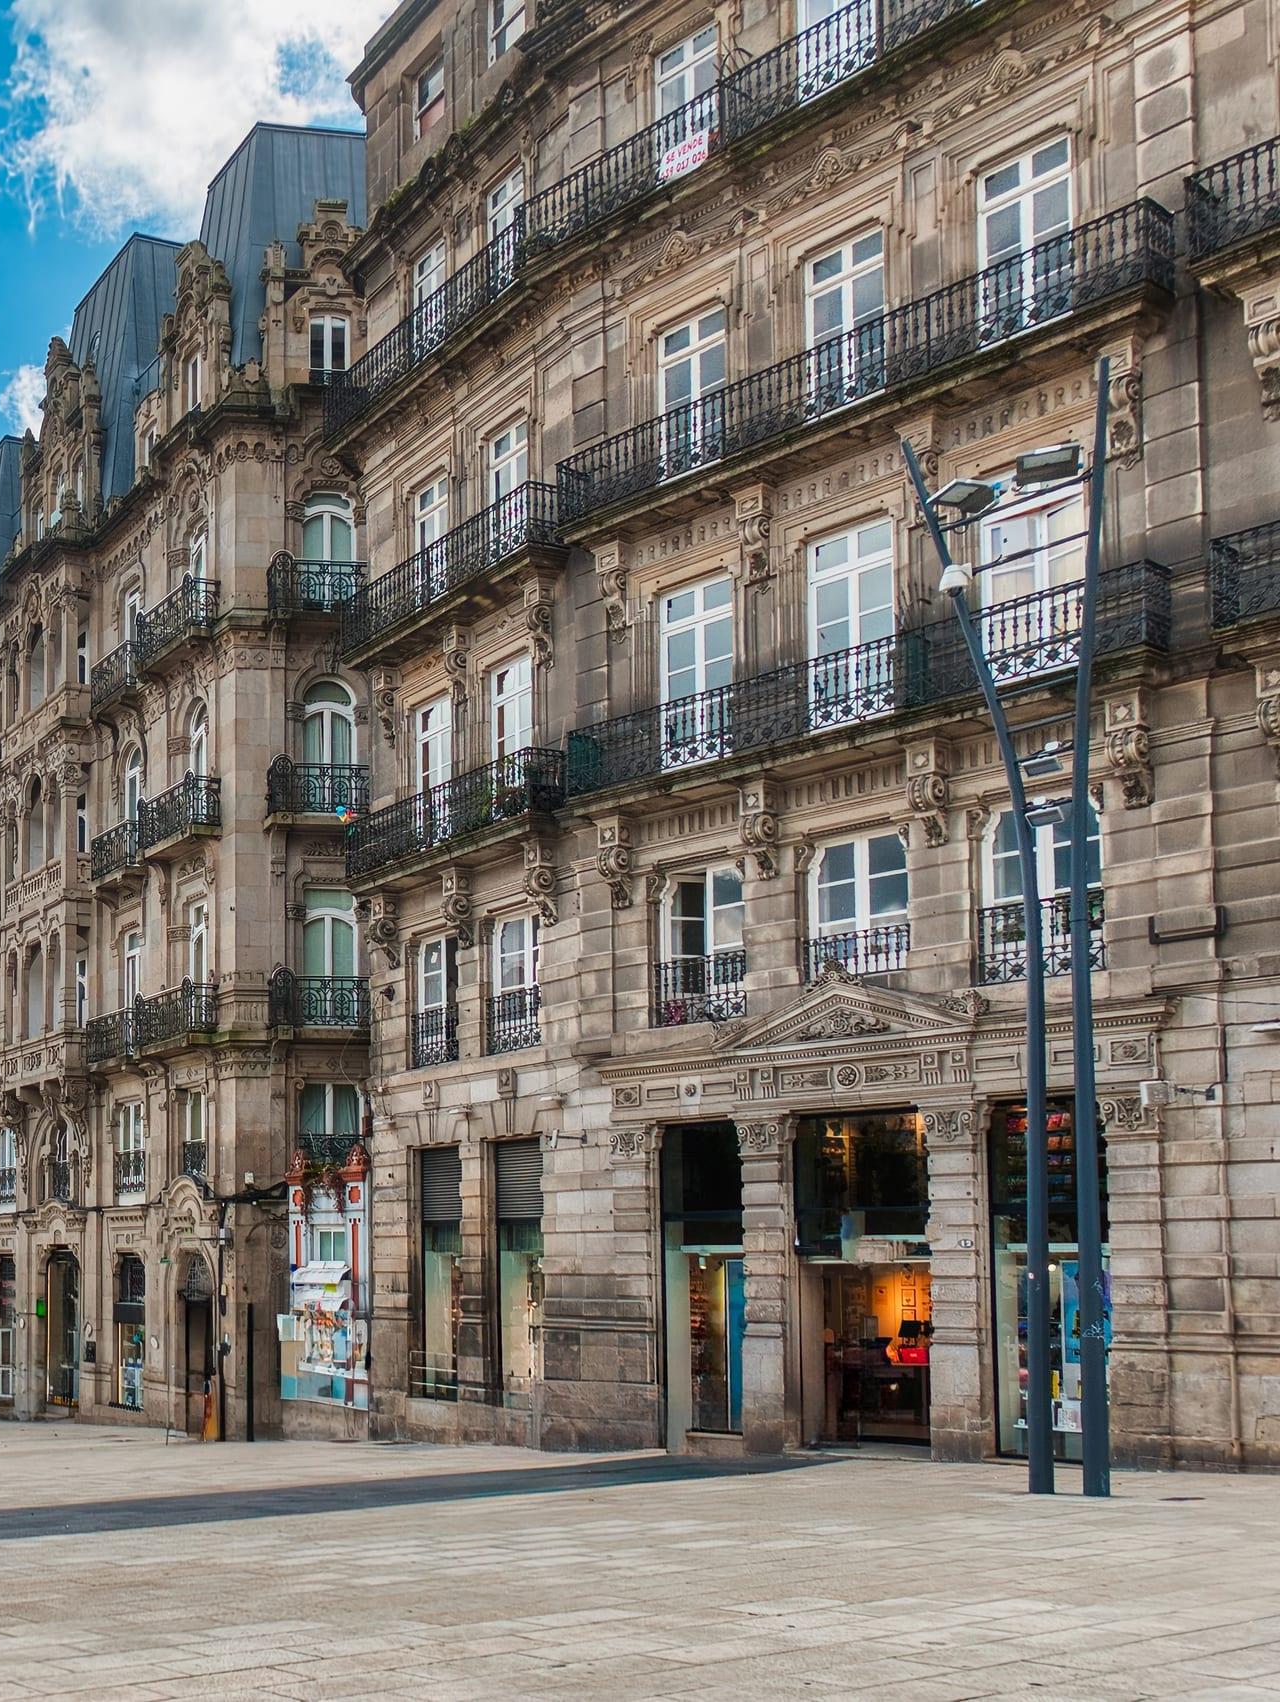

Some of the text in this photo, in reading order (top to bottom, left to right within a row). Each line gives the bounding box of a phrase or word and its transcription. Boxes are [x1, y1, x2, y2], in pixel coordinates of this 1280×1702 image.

[665, 135, 703, 164] SE VENDE
[676, 157, 690, 173] 017
